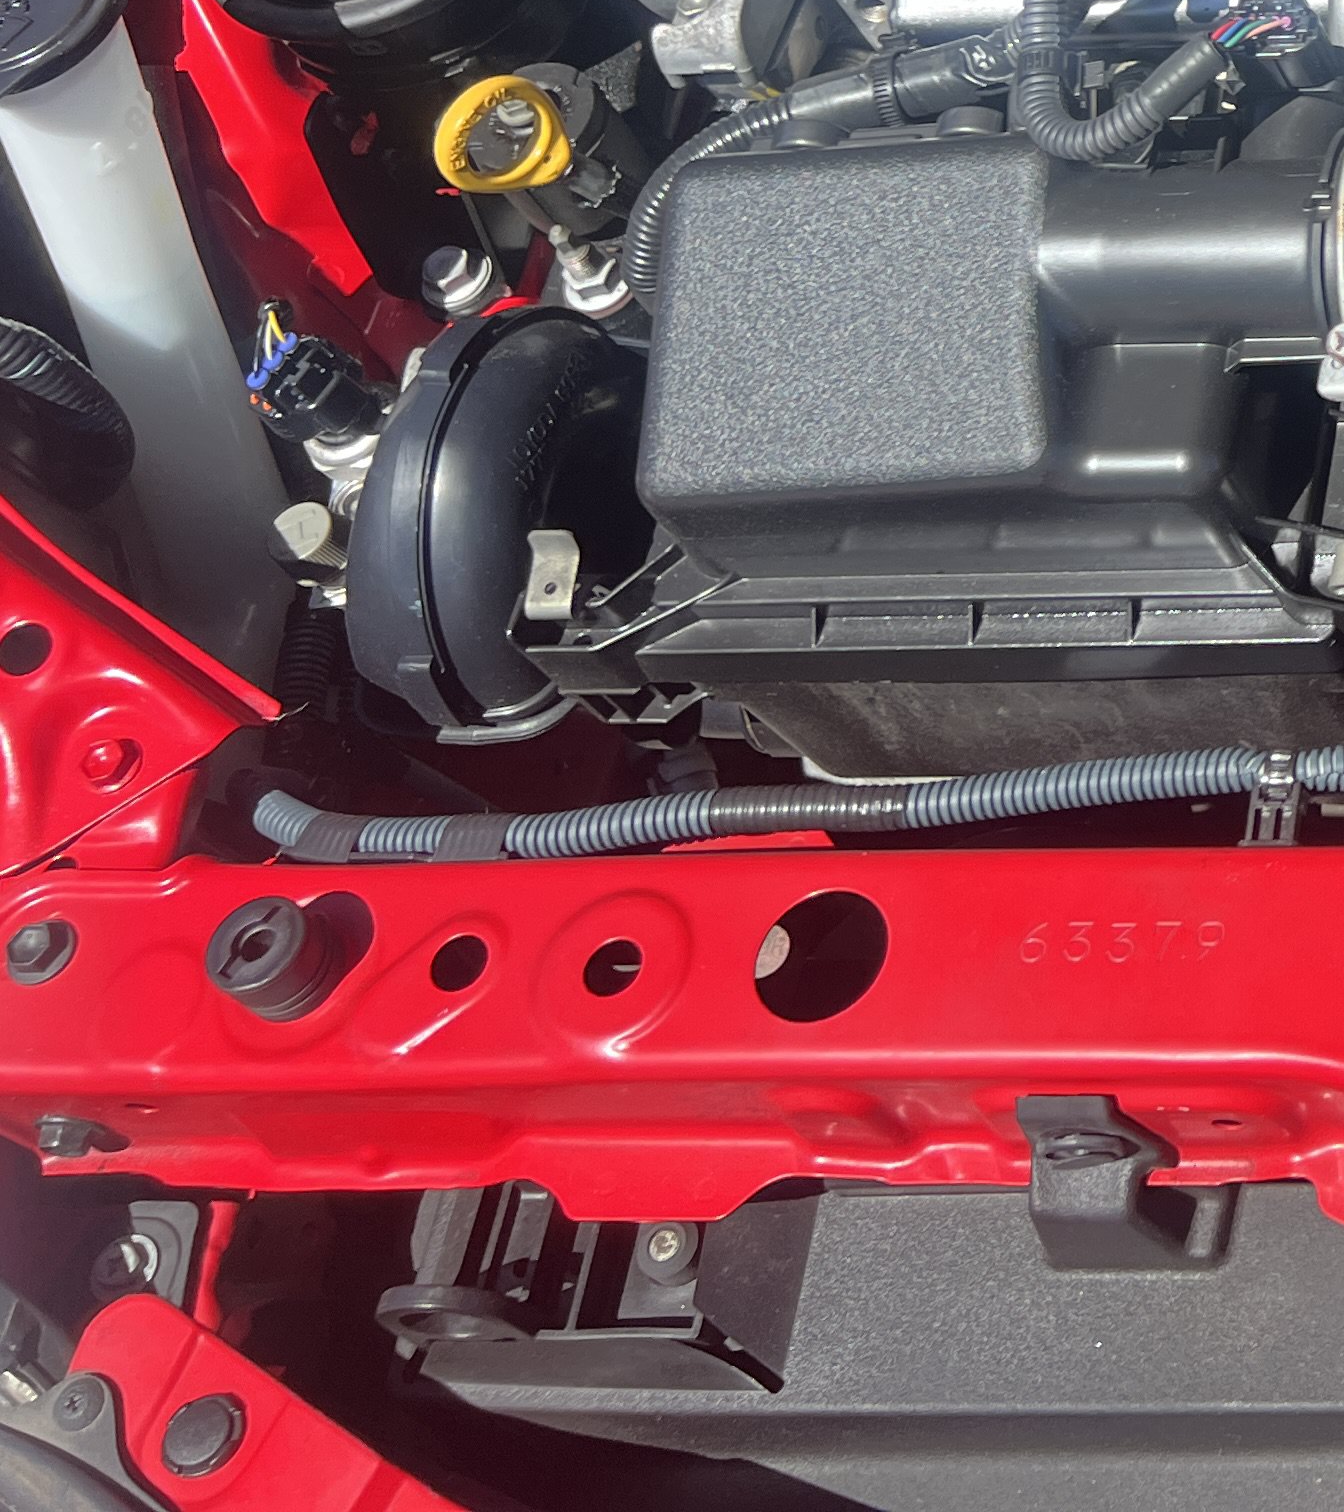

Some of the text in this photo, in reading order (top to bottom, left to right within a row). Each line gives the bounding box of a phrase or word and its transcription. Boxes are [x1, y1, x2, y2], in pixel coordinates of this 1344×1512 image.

[450, 88, 512, 170] ENGINE OIL
[1019, 921, 1225, 964] 63379
